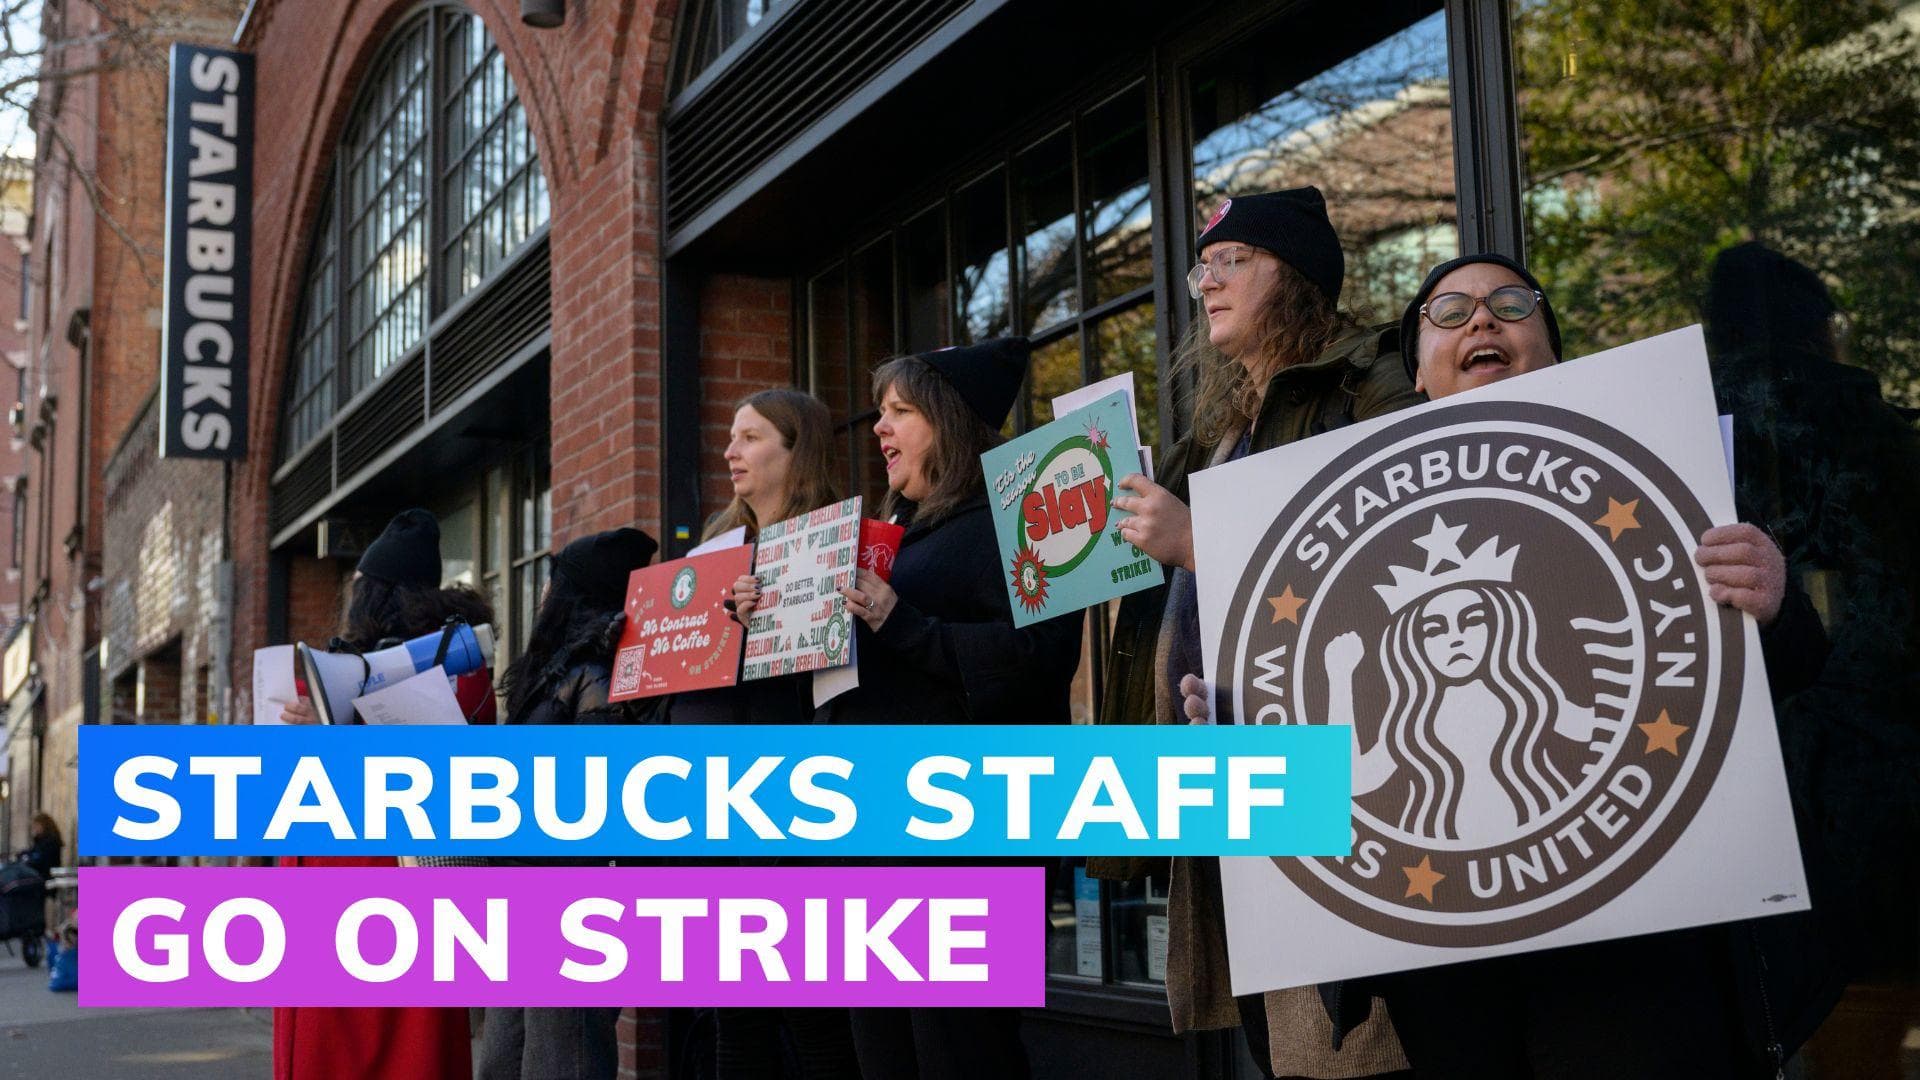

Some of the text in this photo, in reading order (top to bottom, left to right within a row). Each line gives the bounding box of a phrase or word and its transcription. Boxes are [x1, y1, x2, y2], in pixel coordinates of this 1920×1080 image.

[181, 53, 240, 450] STARBUCKS
[1016, 451, 1036, 475] the
[1055, 463, 1086, 487] TO BE
[1000, 471, 1037, 510] season
[841, 497, 854, 517] RED
[1022, 474, 1108, 541] Slay
[1296, 443, 1600, 571] STARBUCKS
[839, 520, 852, 542] RED
[837, 546, 850, 567] RED
[1111, 558, 1152, 583] STRIKE!
[785, 576, 814, 593] DO BETTER,
[782, 590, 815, 608] STARBUCKS!
[640, 611, 709, 637] No Contract
[1633, 544, 1696, 687] N.Y.C
[650, 630, 711, 656] No Coffee
[1468, 765, 1652, 898] UNITED
